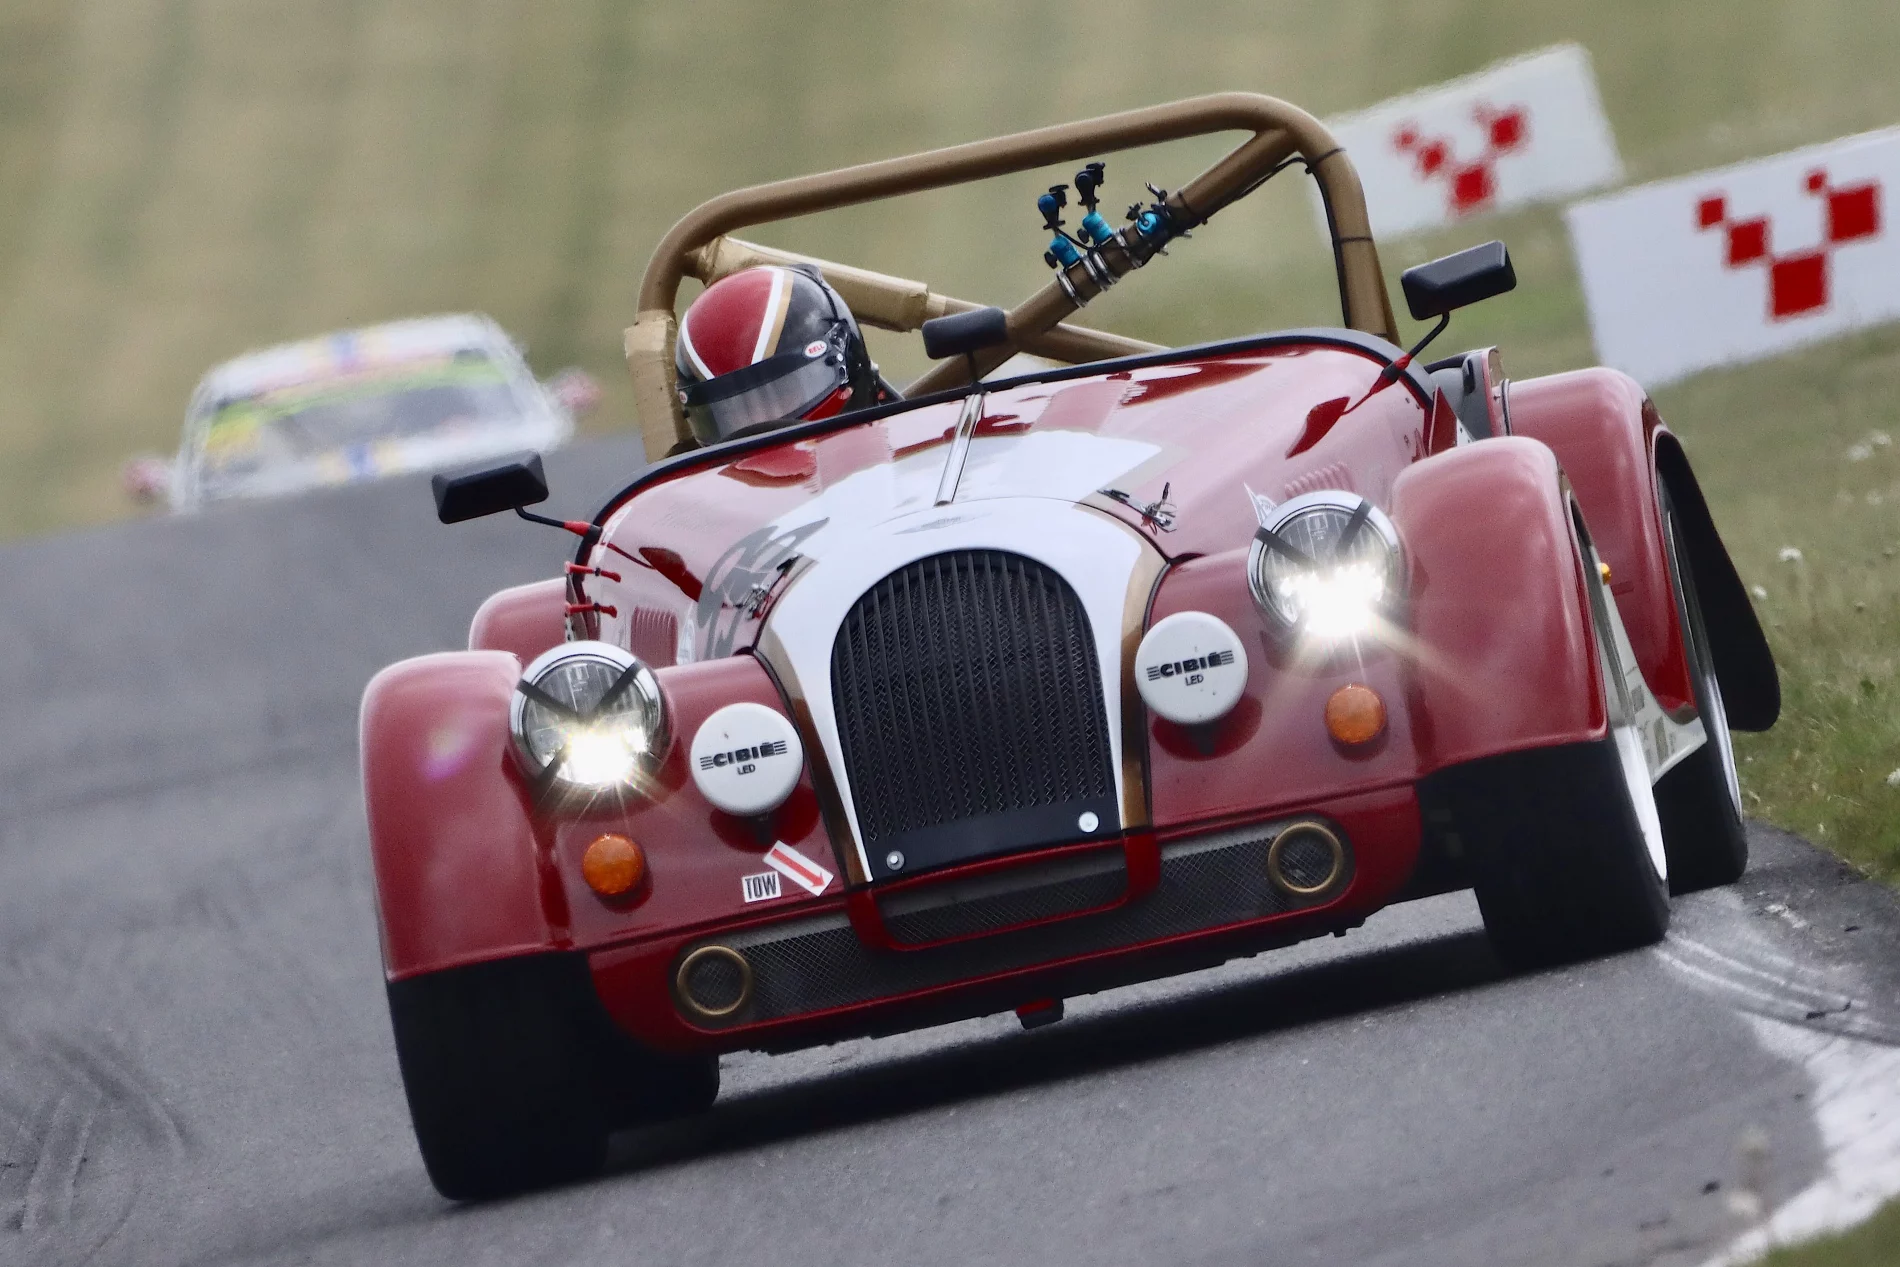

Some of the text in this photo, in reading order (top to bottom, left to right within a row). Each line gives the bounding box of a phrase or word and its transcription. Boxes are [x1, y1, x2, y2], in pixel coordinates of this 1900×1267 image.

[808, 344, 825, 354] BELL
[1185, 674, 1204, 687] LED
[737, 764, 756, 775] LED
[745, 873, 777, 899] TOW
